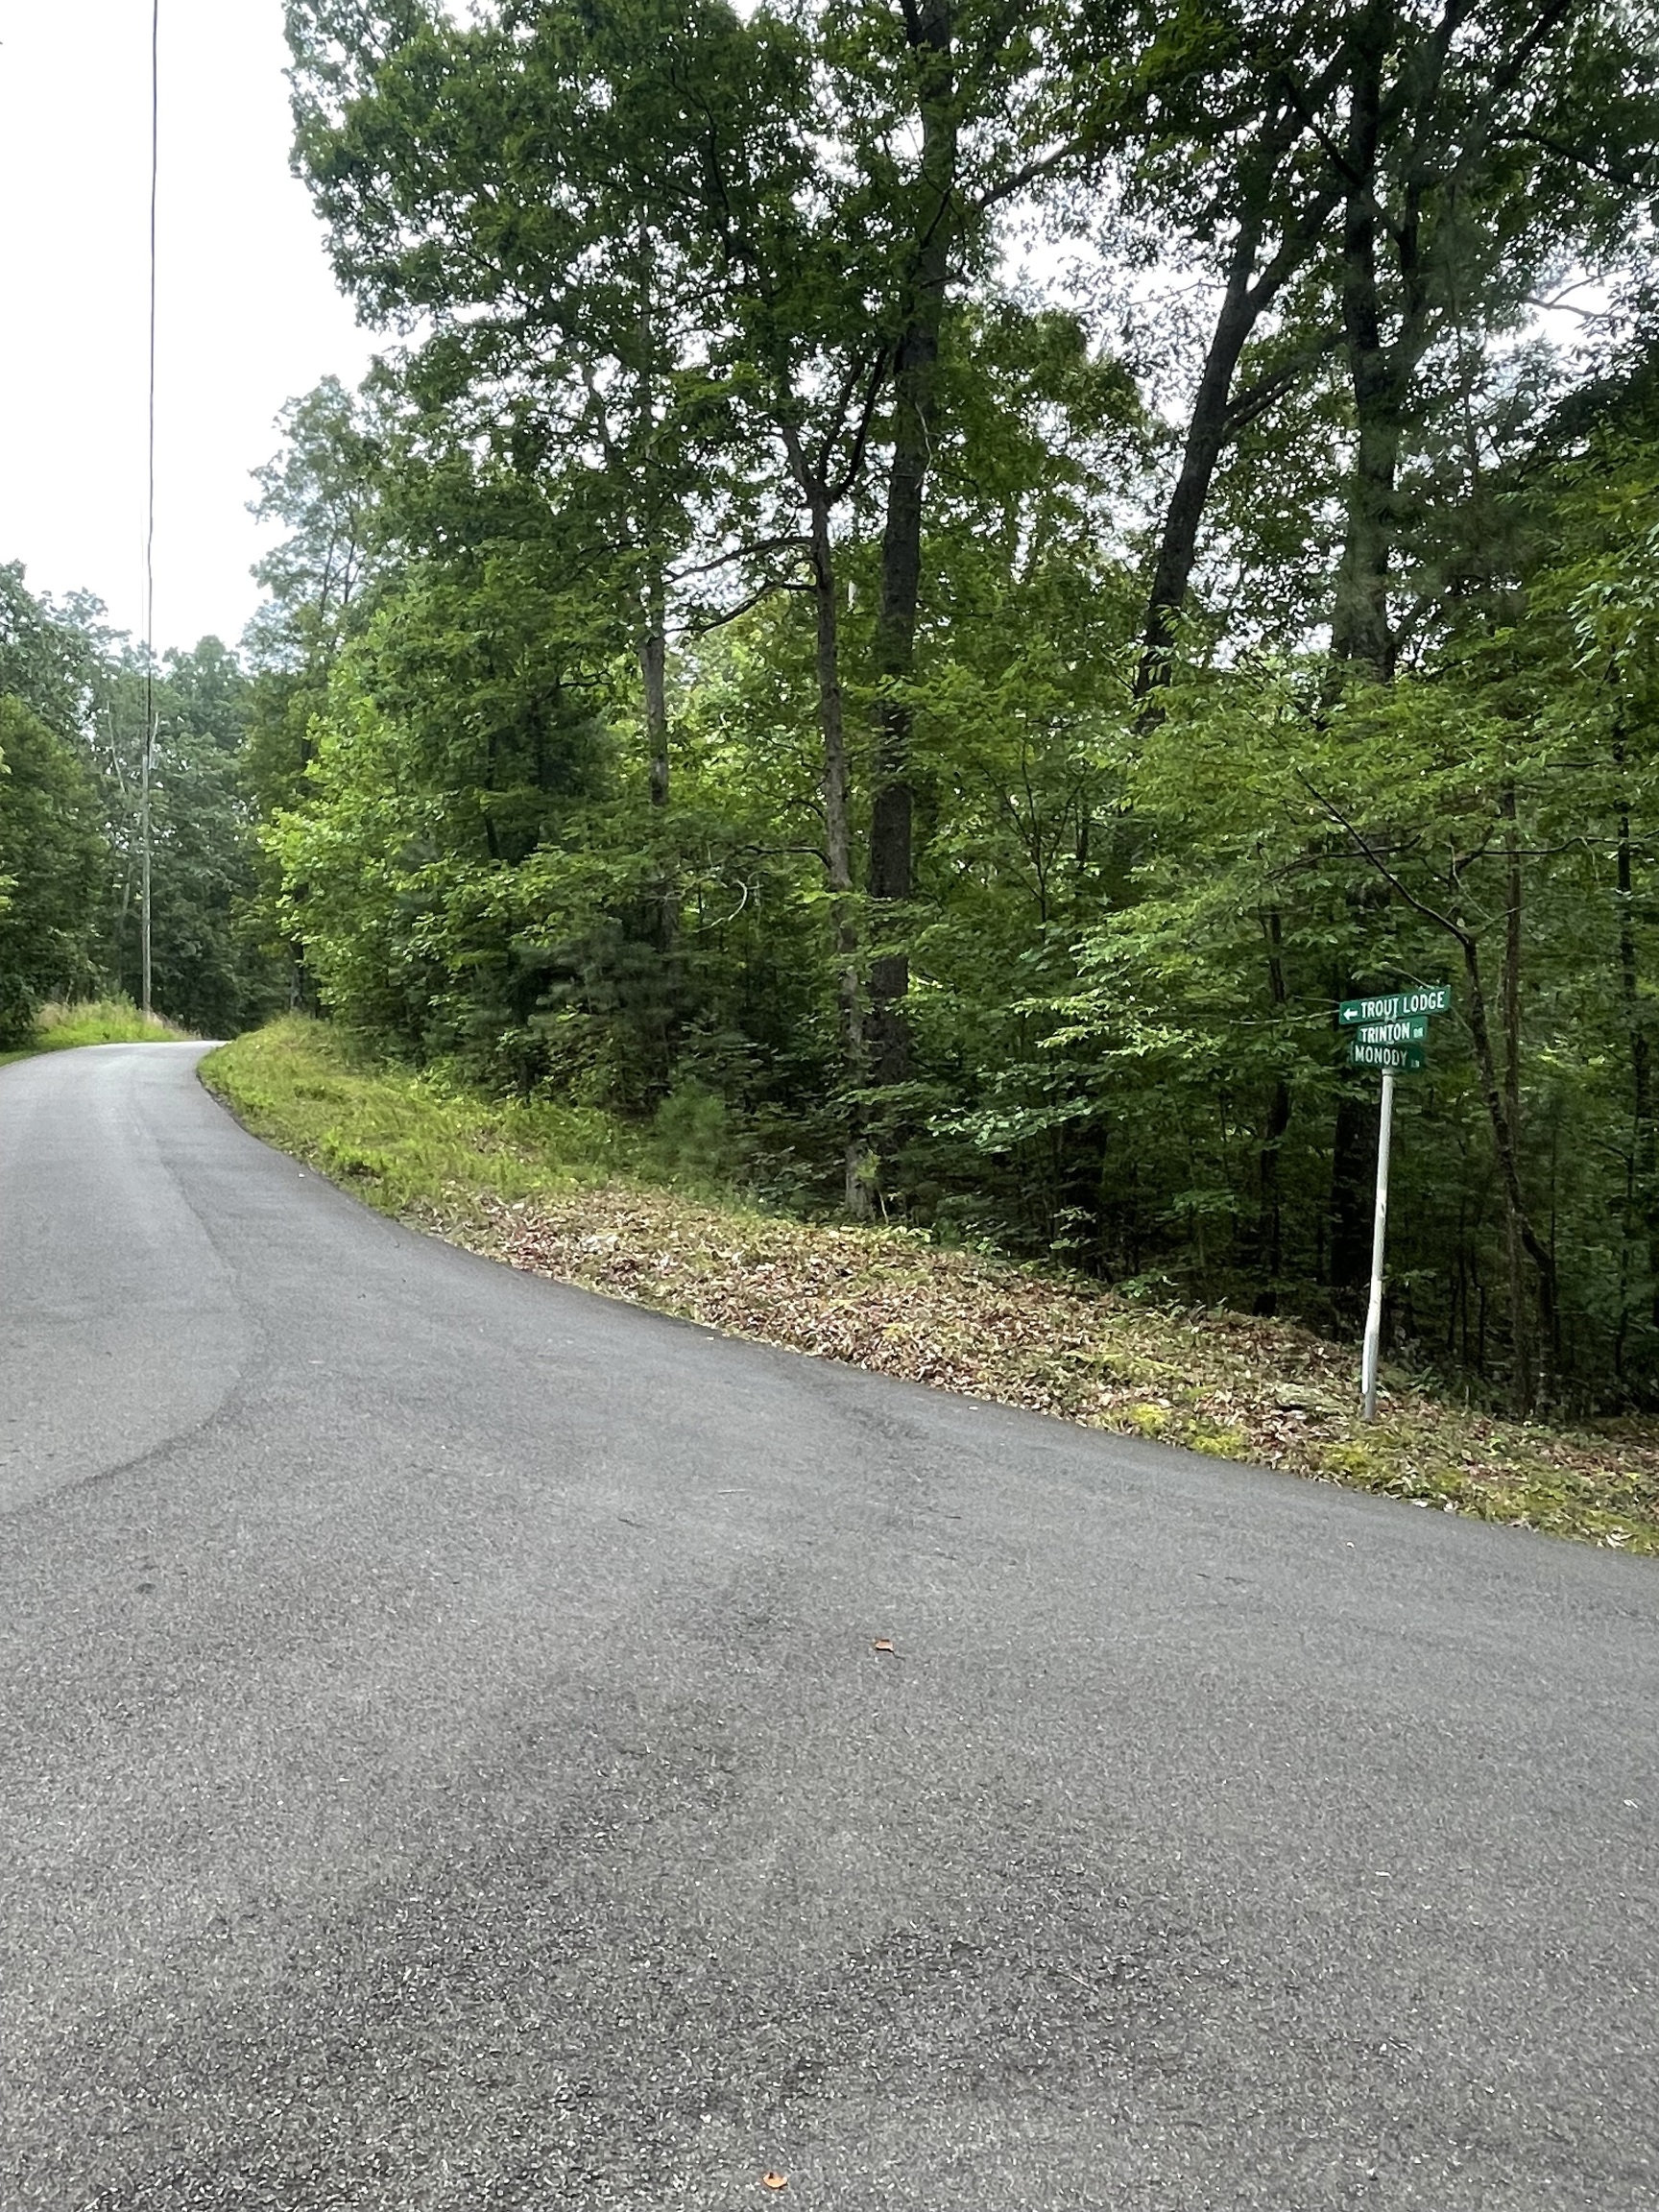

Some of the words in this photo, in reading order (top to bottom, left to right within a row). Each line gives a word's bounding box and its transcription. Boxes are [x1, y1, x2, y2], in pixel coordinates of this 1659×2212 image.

[1360, 998, 1399, 1018] TROUT
[1403, 991, 1445, 1014] LODGE
[1359, 1022, 1410, 1044] TRINTON
[1355, 1045, 1408, 1067] MONODY
